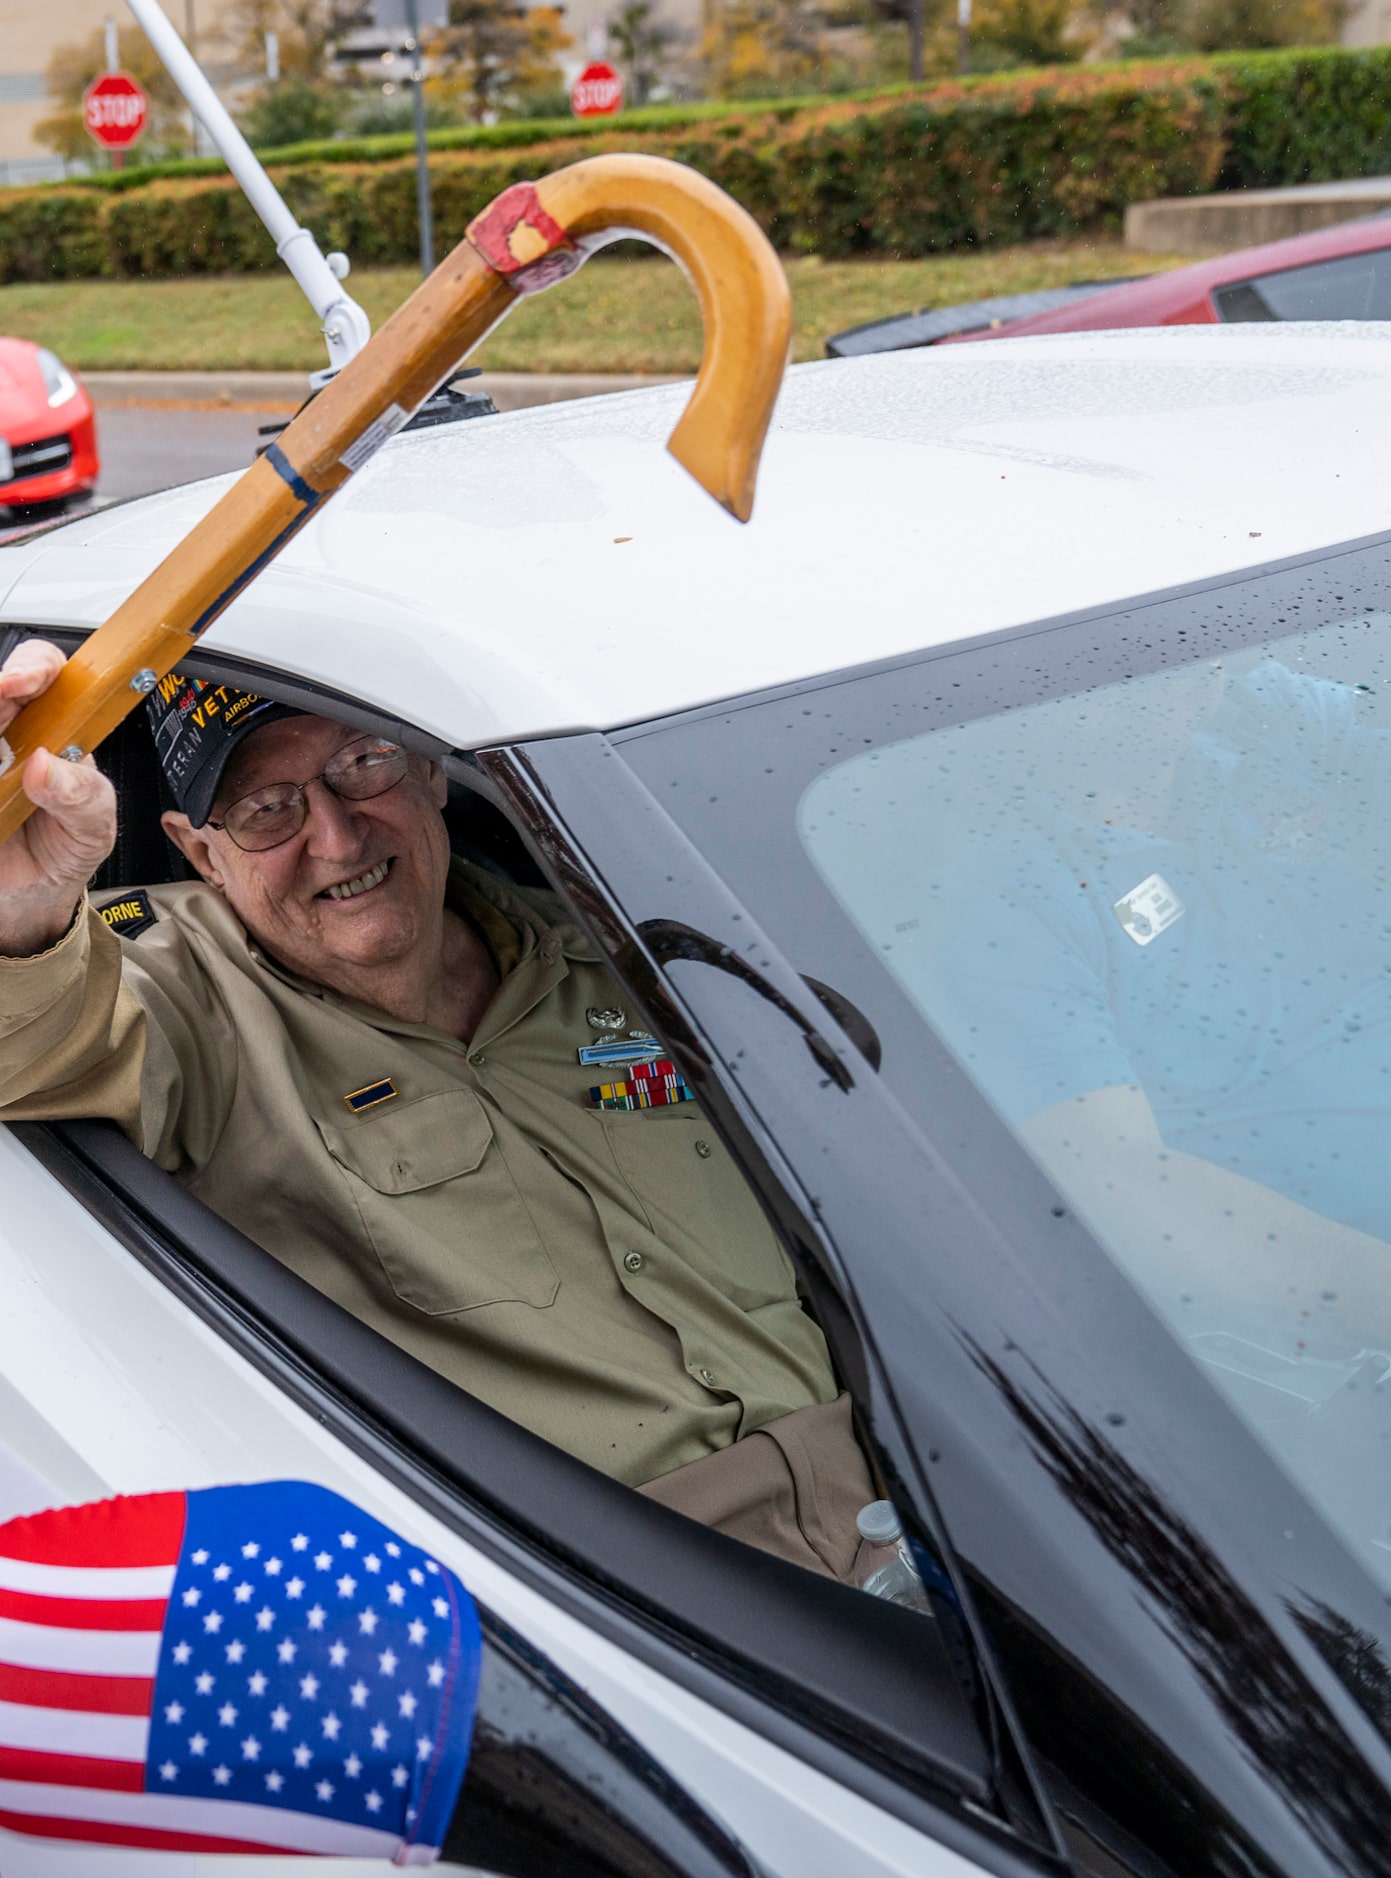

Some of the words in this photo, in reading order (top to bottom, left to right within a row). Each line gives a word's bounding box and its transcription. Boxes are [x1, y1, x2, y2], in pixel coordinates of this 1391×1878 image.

[88, 94, 145, 127] STOP
[574, 80, 621, 110] STOP
[191, 685, 240, 728] VET
[224, 693, 261, 722] AIRBO
[167, 727, 202, 791] TERAN
[102, 901, 144, 925] ORNE
